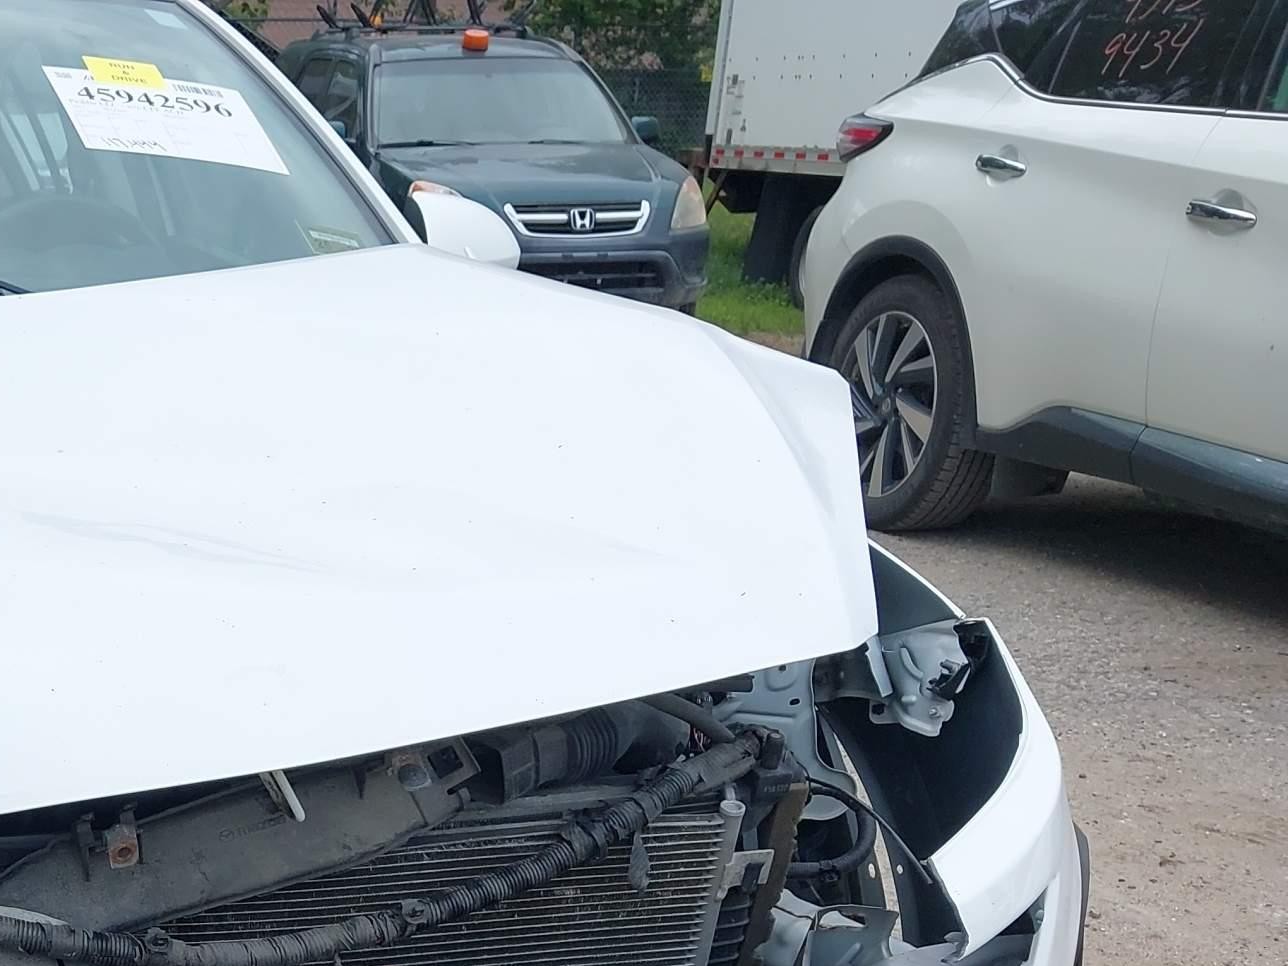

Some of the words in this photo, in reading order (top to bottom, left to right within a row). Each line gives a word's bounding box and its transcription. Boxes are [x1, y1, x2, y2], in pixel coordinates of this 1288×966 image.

[1101, 18, 1205, 79] 9434
[111, 73, 148, 85] DRIVE
[76, 85, 234, 118] 45942596
